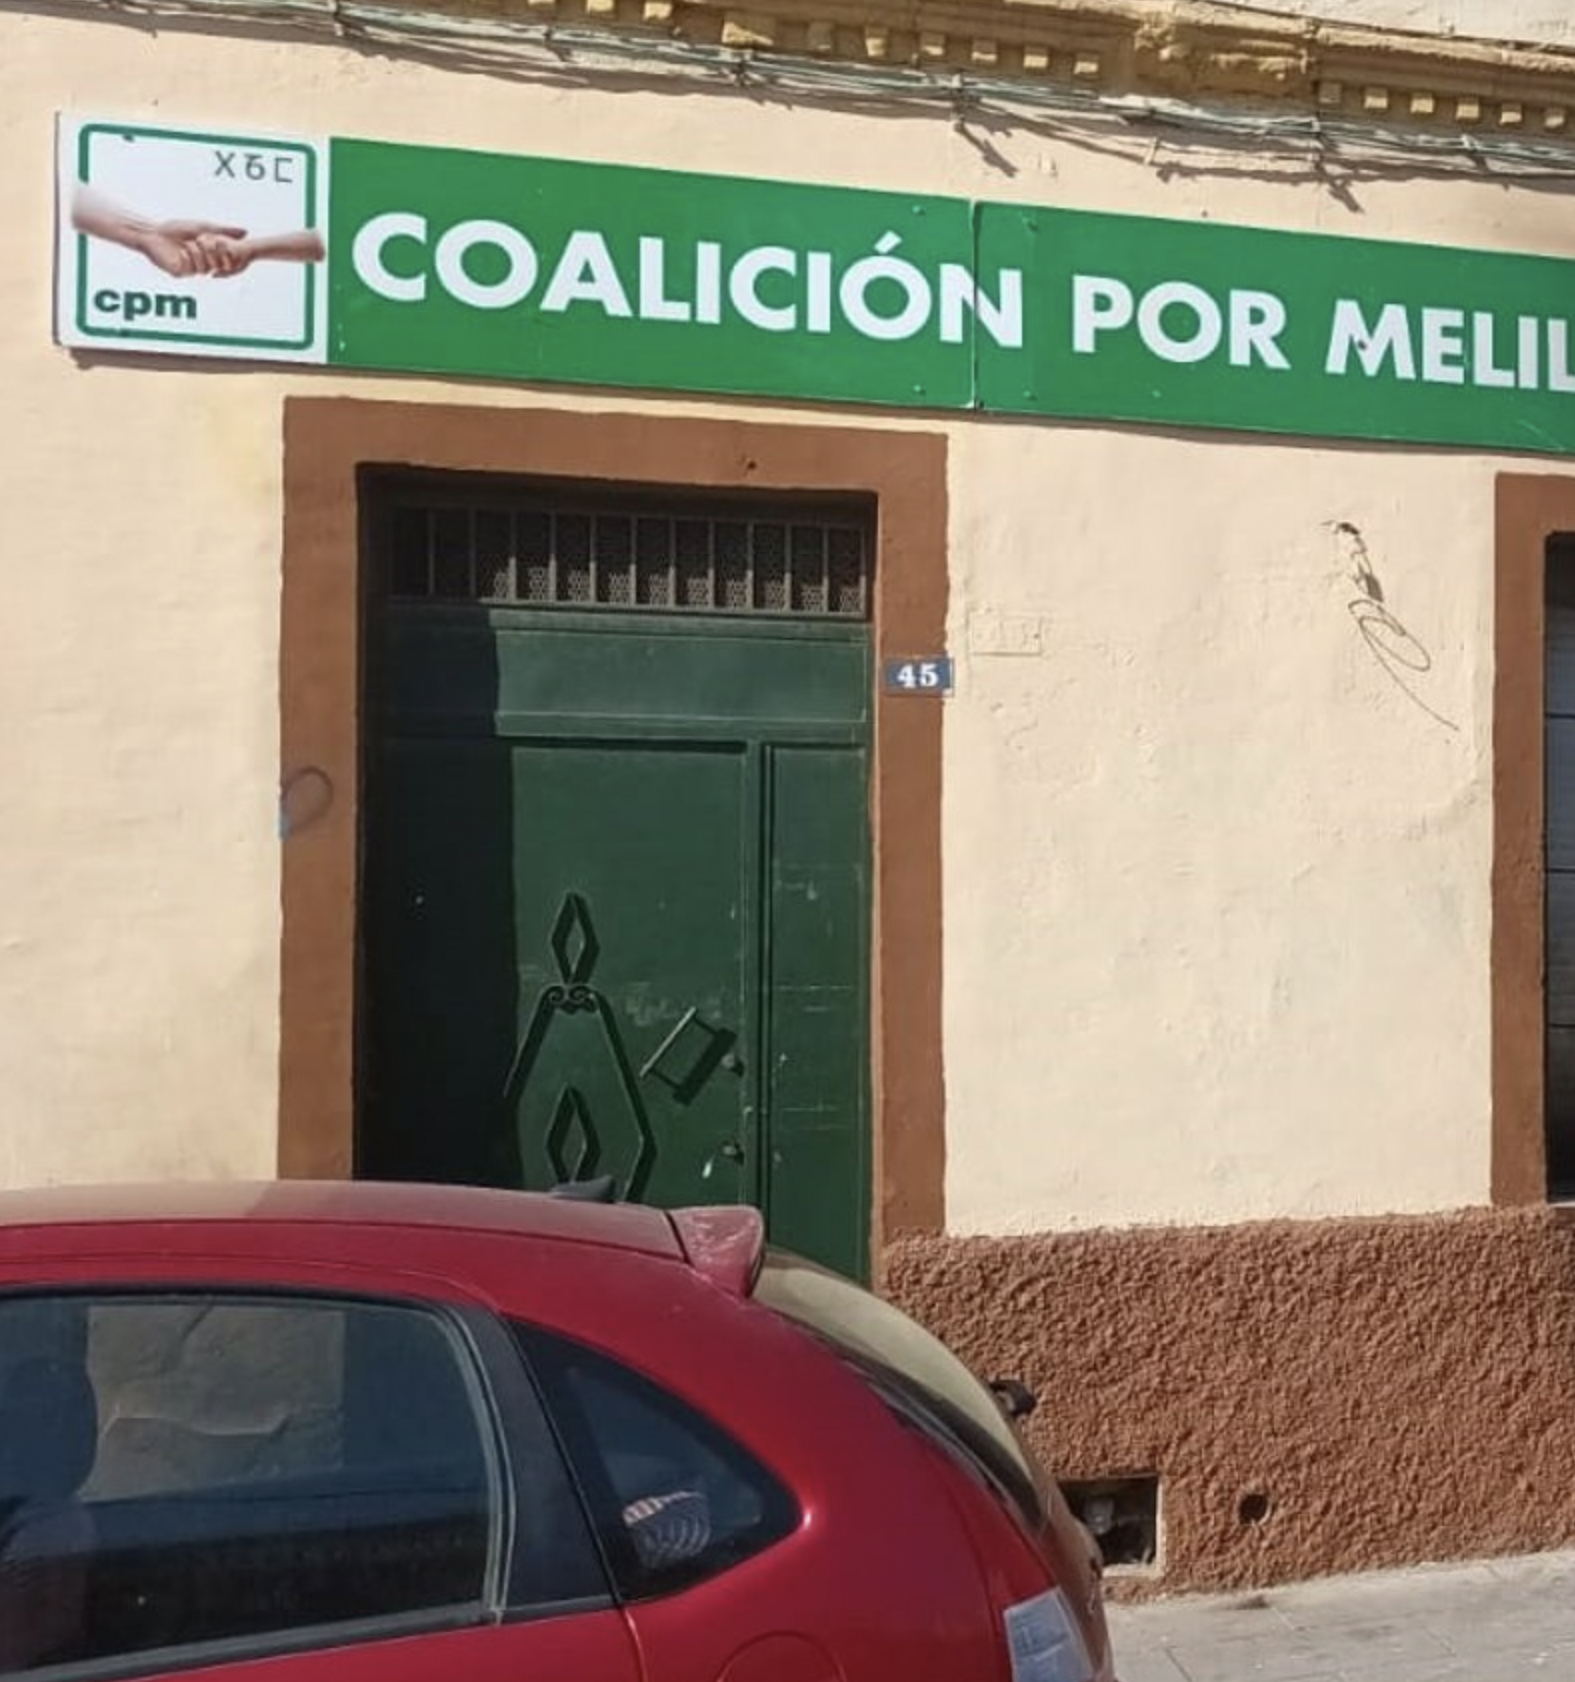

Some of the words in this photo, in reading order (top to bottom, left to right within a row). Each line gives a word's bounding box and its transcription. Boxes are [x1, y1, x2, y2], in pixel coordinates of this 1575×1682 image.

[93, 289, 198, 320] cpm
[352, 212, 1023, 347] COALICIÓN
[1073, 275, 1290, 370] POR
[897, 663, 939, 688] 45
